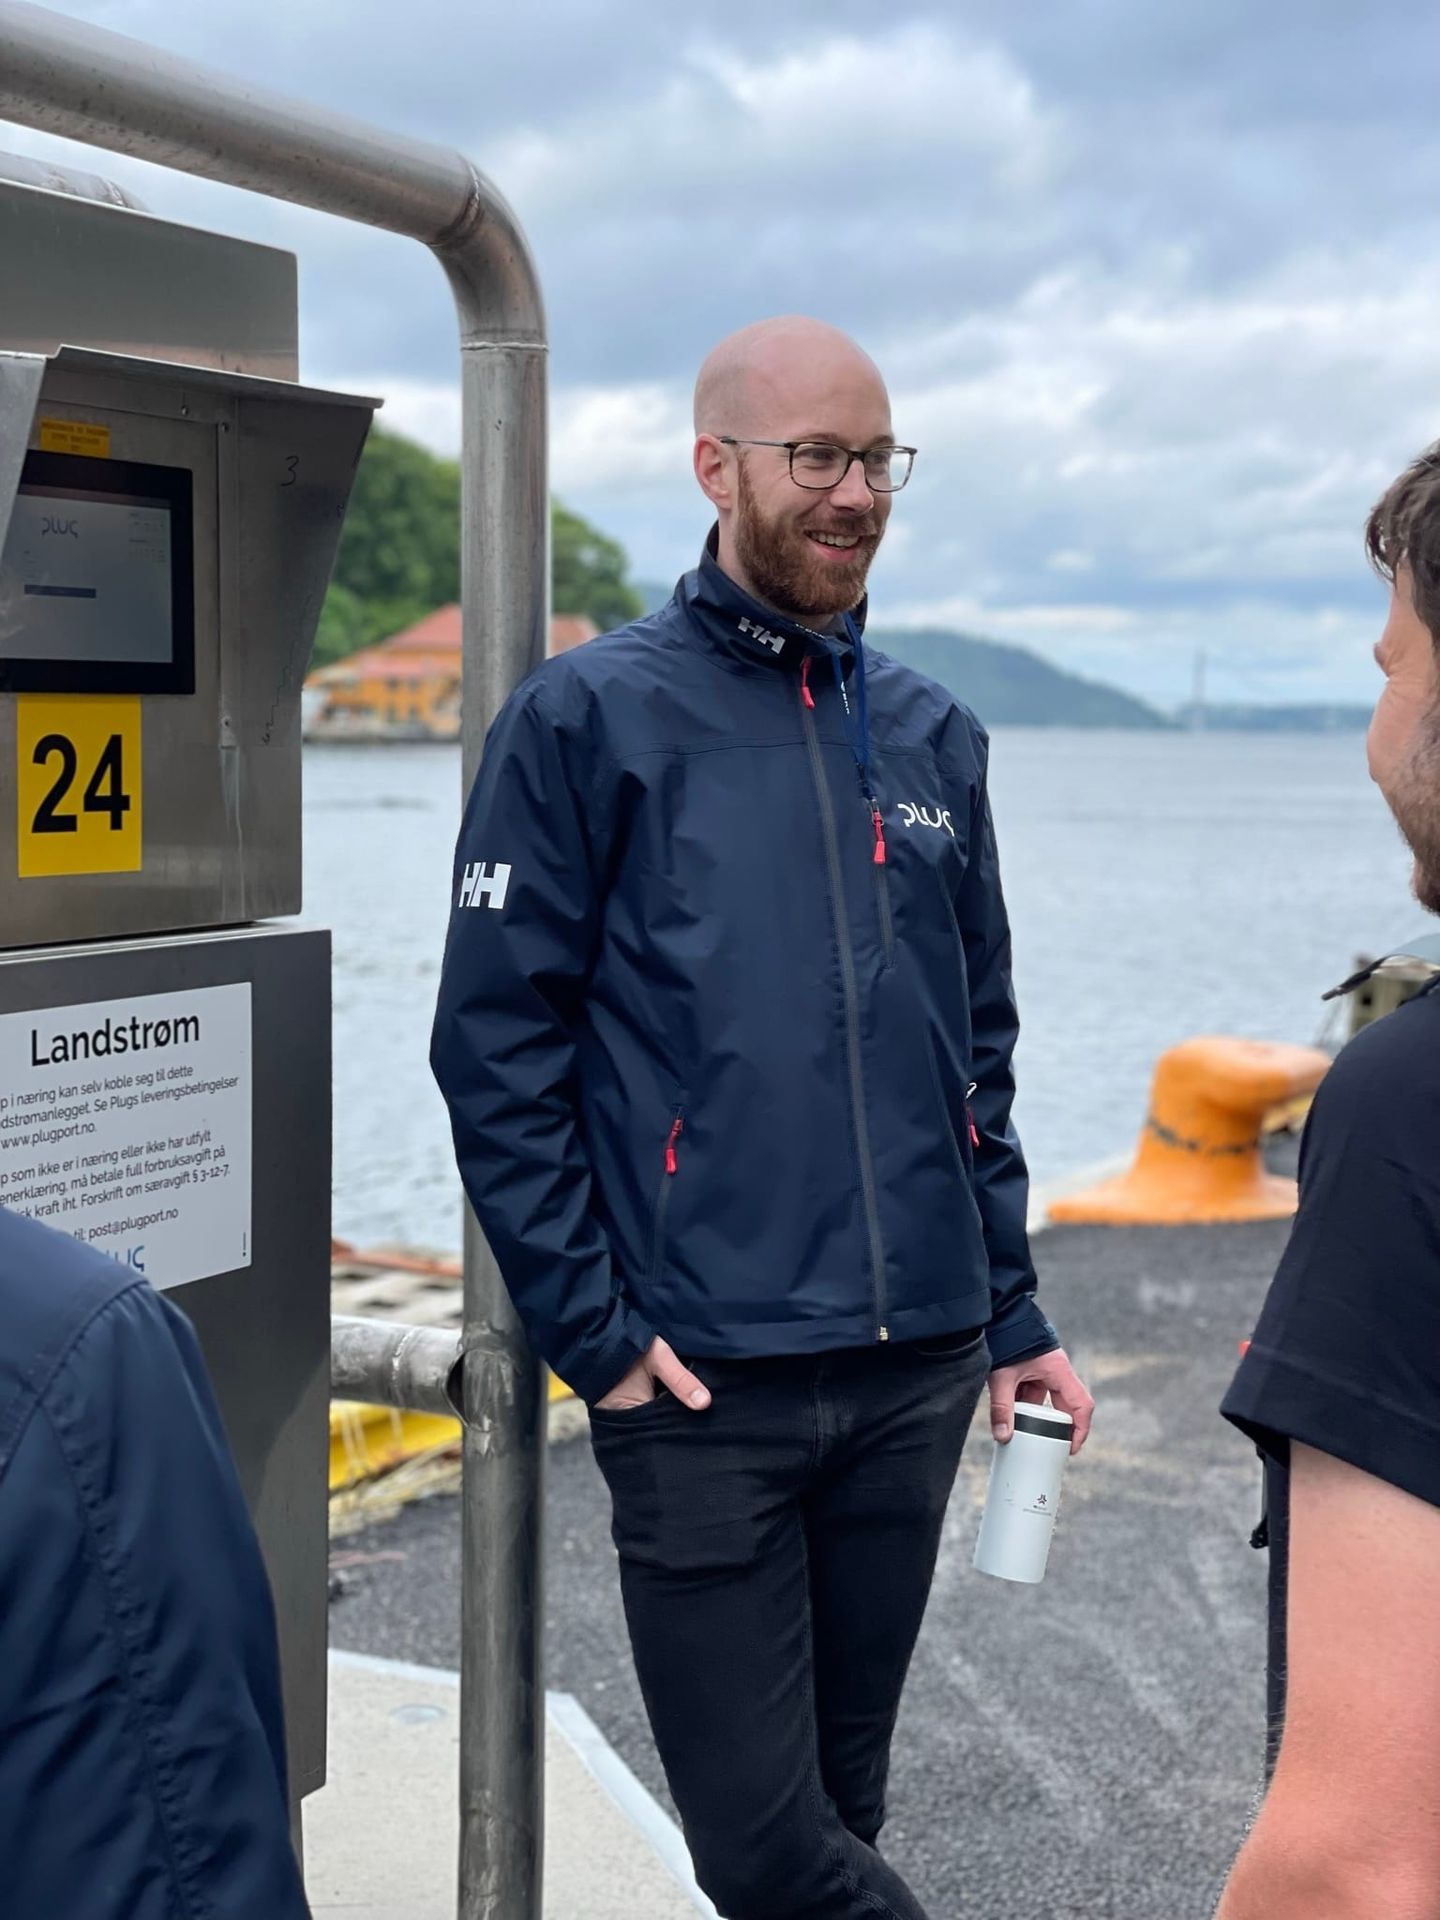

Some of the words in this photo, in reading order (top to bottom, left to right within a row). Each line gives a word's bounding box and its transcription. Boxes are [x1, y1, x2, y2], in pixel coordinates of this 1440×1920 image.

[280, 455, 300, 487] 3
[737, 616, 786, 654] HH
[31, 733, 131, 833] 24
[458, 861, 512, 910] HH
[31, 1014, 201, 1067] Landstrøm
[10, 1092, 14, 1107] i
[17, 1088, 56, 1105] næring
[58, 1085, 79, 1099] kan
[80, 1079, 103, 1096] selv
[103, 1074, 133, 1091] koble
[135, 1073, 154, 1087] seg
[156, 1068, 166, 1082] til
[167, 1065, 194, 1080] dette
[93, 1098, 108, 1113] Se
[110, 1094, 139, 1110] Plugs
[141, 1076, 239, 1104] leveringsbetingelser
[11, 1167, 36, 1183] som
[38, 1162, 61, 1177] ikke
[62, 1159, 74, 1172] er
[81, 1149, 119, 1166] næring
[121, 1144, 144, 1160] eller
[145, 1140, 166, 1155] ikke
[168, 1137, 184, 1150] har
[185, 1129, 212, 1147] utfylt
[71, 1174, 88, 1190] må
[90, 1168, 124, 1187] betale
[126, 1160, 142, 1178] full
[144, 1147, 212, 1174] forbruksavgift
[213, 1144, 226, 1162] på
[34, 1200, 60, 1218] kraft
[81, 1185, 124, 1207] Forskrift
[125, 1184, 143, 1198] om
[144, 1170, 191, 1190] særavgift
[88, 1207, 180, 1243] post@plugport.no
